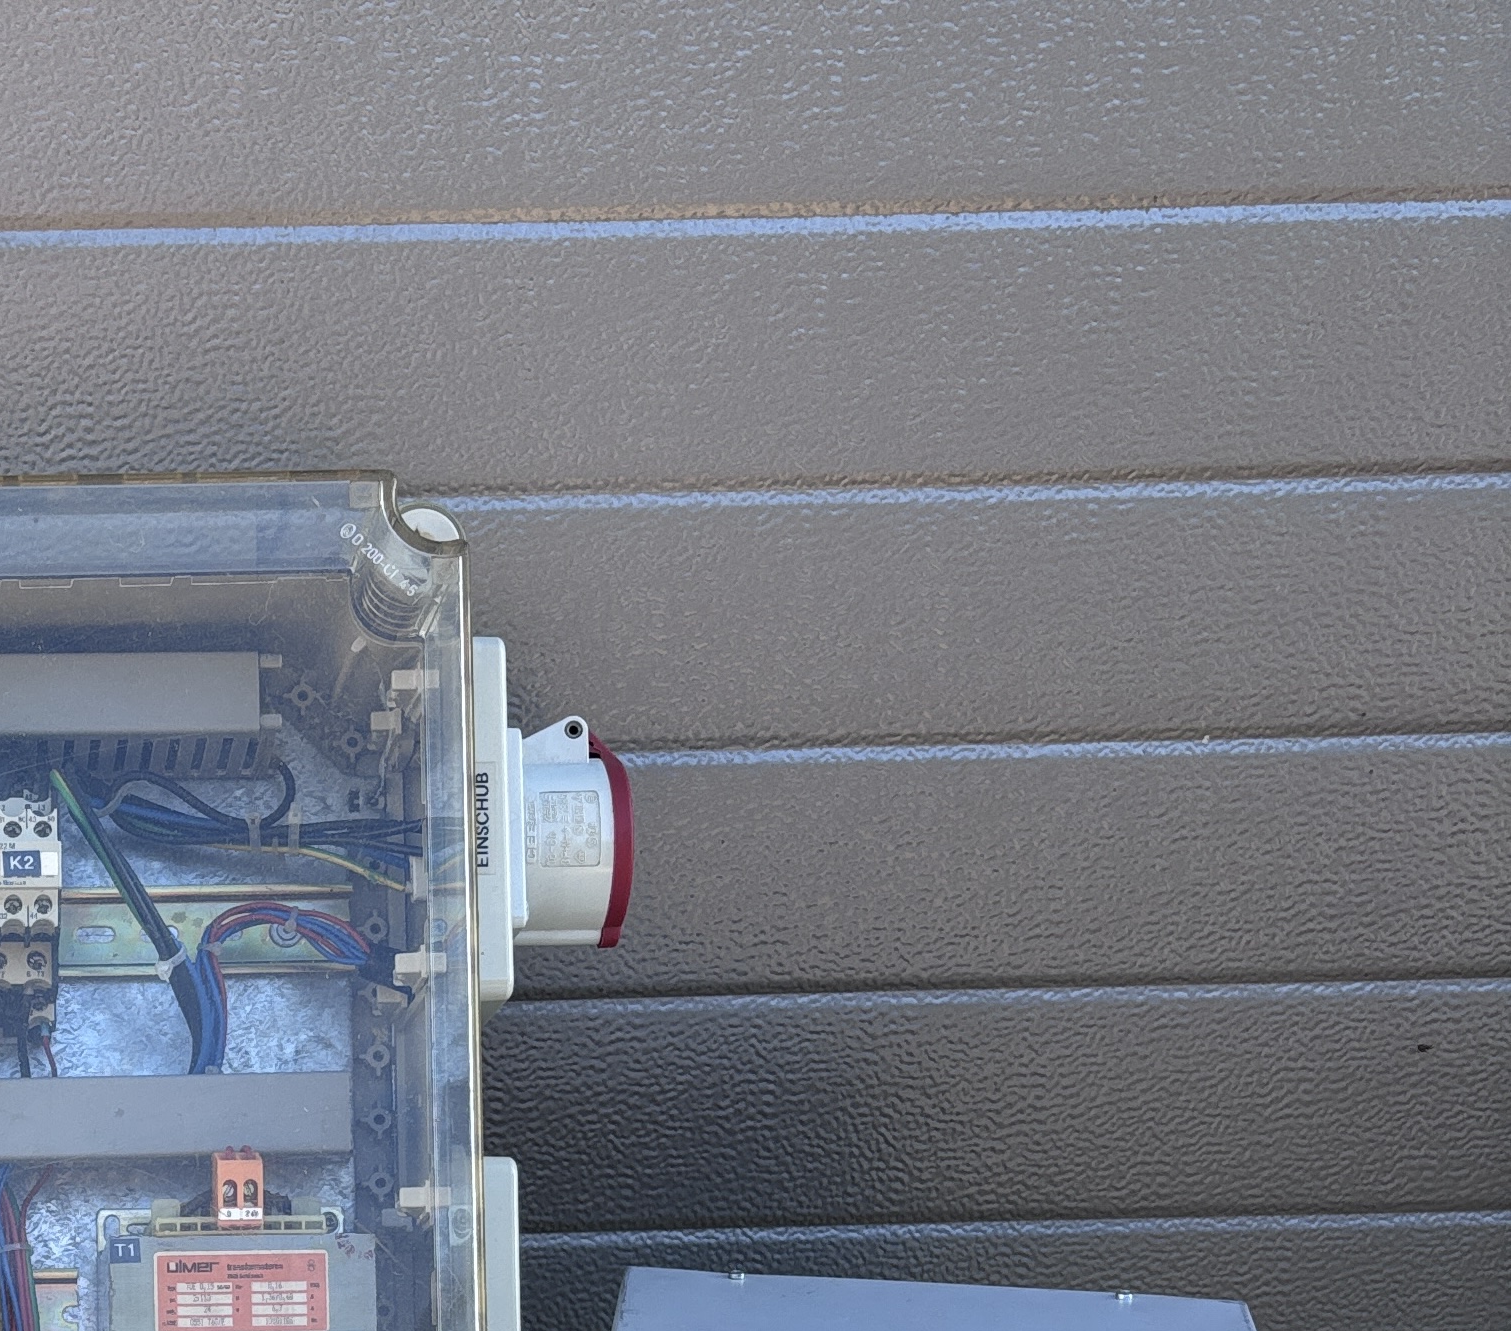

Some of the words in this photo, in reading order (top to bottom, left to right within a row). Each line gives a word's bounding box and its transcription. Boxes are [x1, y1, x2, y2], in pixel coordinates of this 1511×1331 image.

[476, 772, 489, 868] EINSCHUB
[9, 855, 35, 870] K2
[114, 1244, 135, 1257] T1
